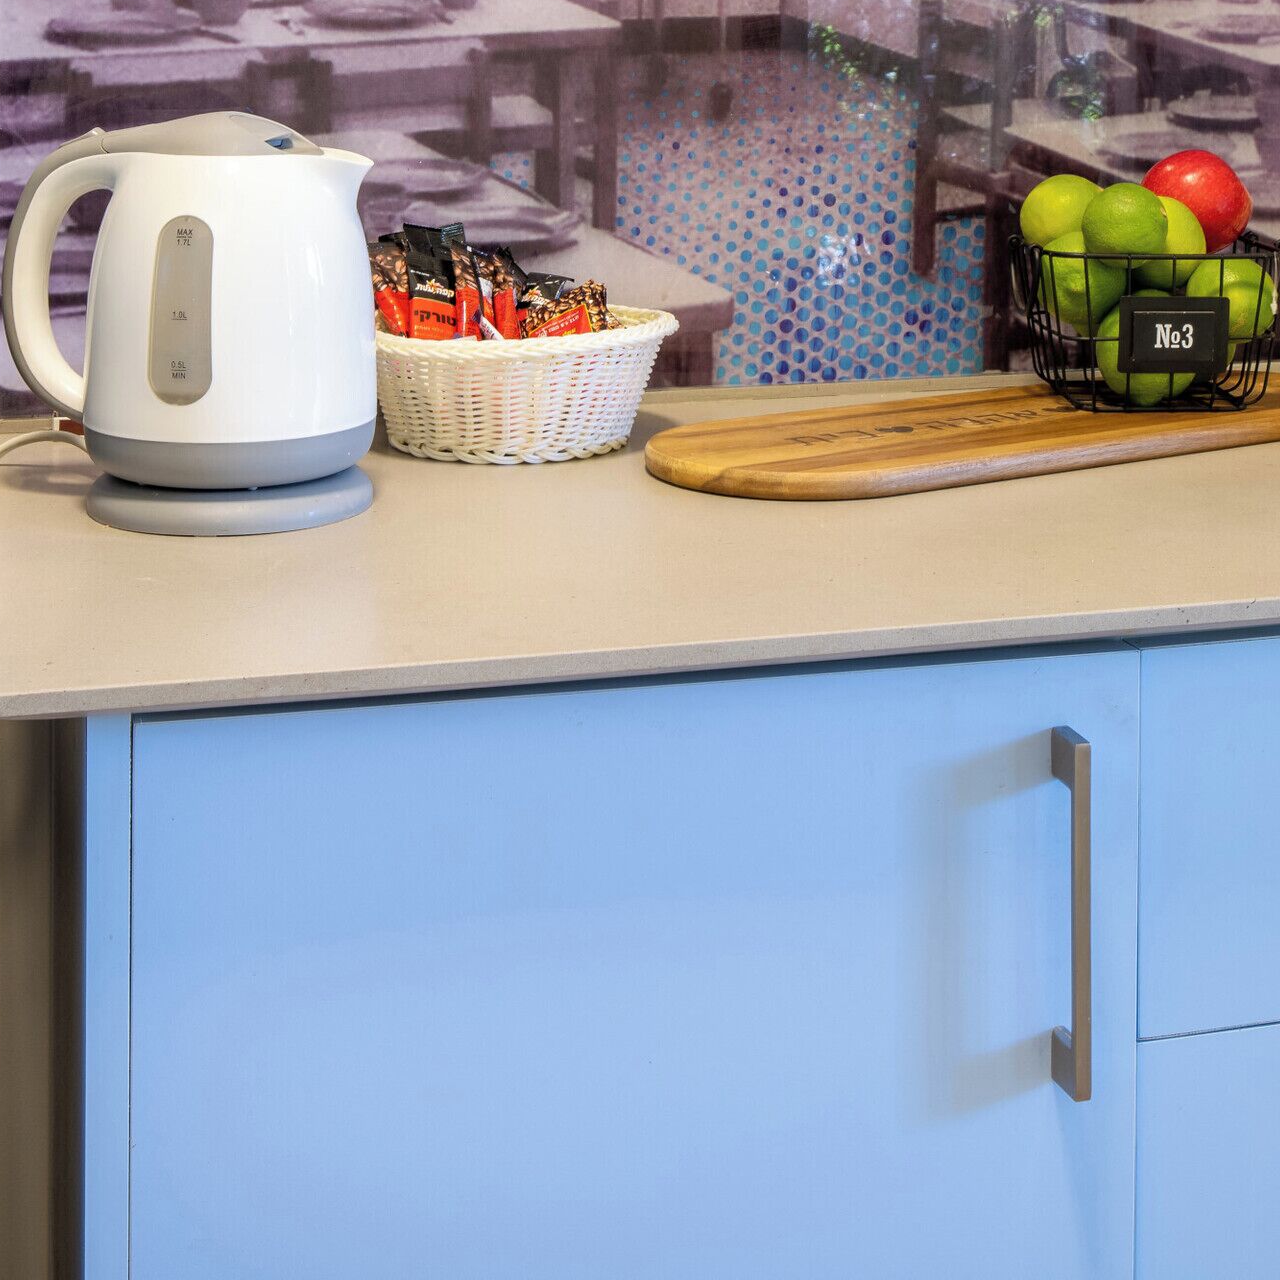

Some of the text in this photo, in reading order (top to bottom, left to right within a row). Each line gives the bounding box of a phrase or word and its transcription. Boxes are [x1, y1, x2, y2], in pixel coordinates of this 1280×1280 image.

[176, 228, 193, 236] MAX
[176, 238, 191, 246] 1.7L
[172, 311, 187, 319] 1.0L
[414, 310, 457, 327] טורקי
[170, 360, 186, 369] 0.5L
[171, 371, 186, 380] MIN
